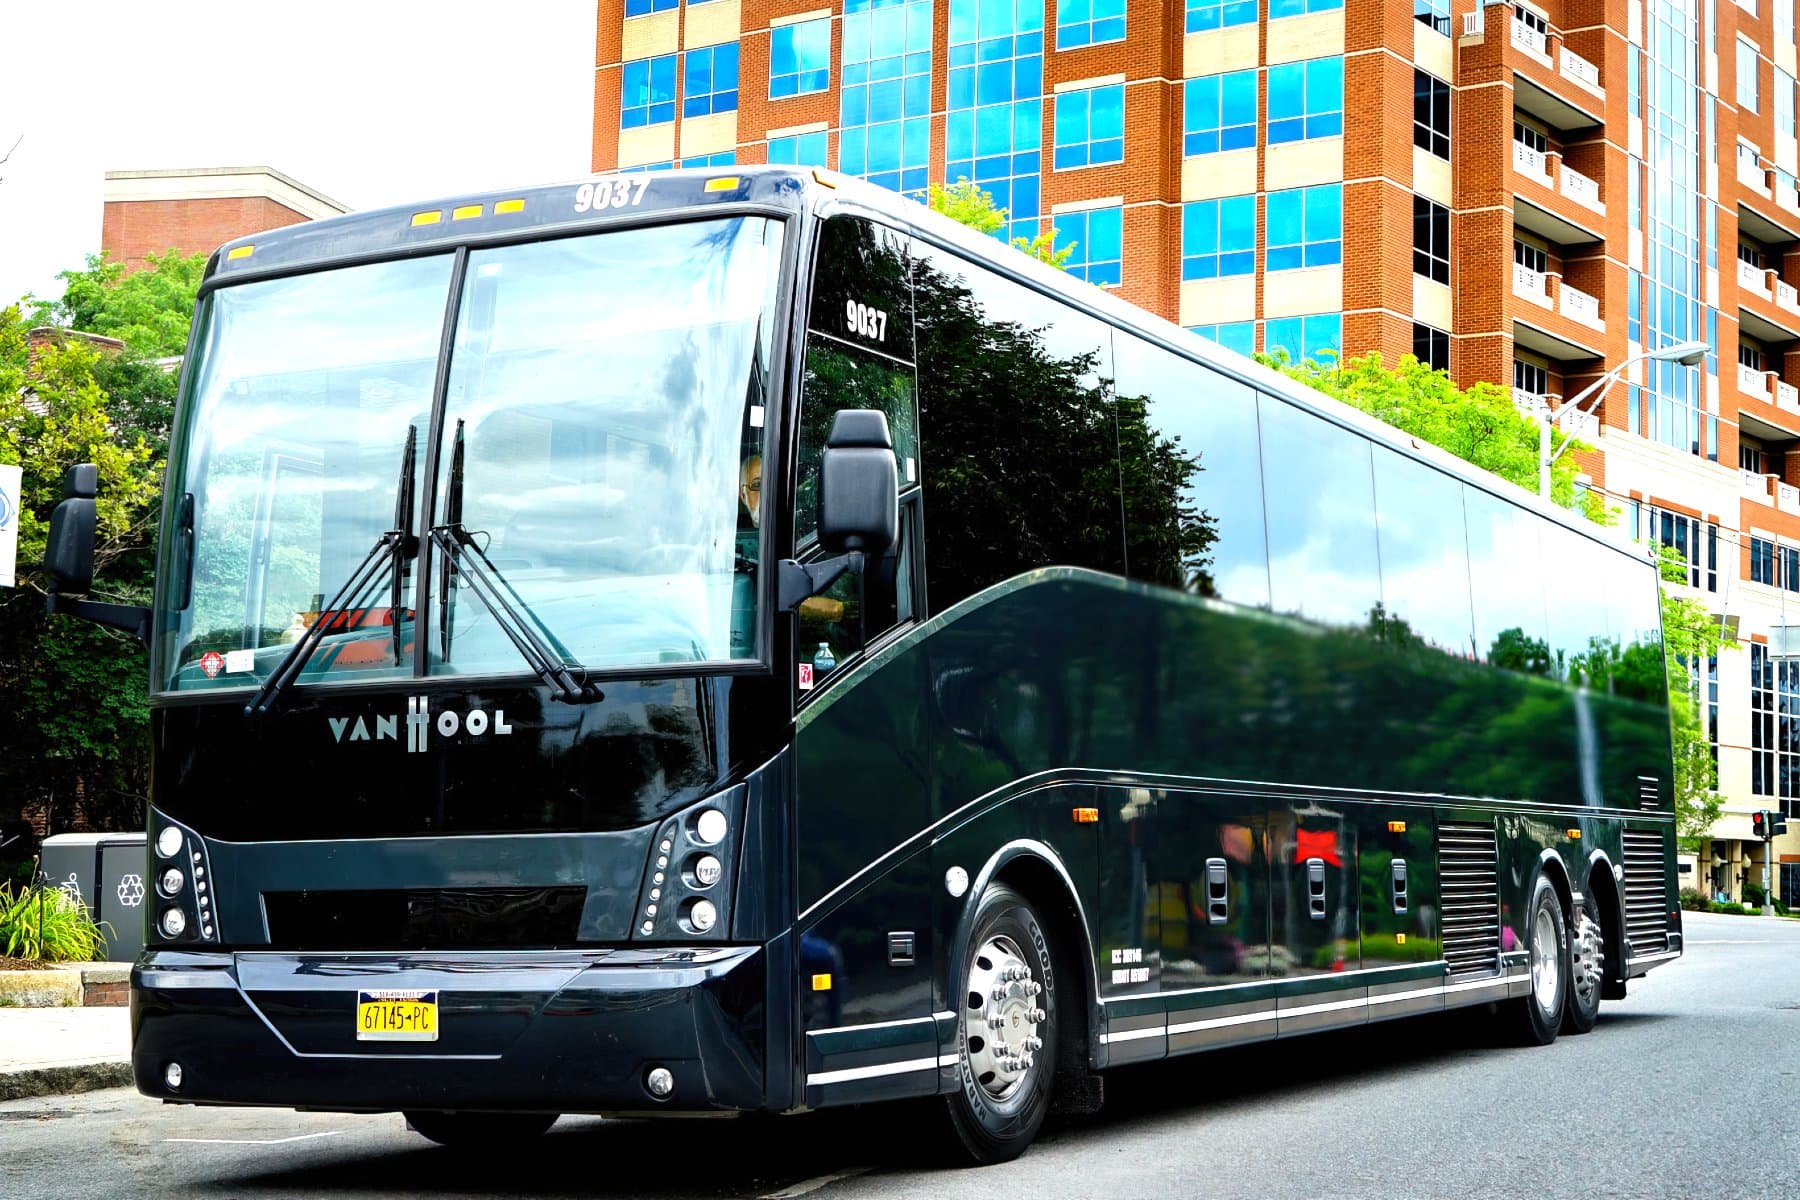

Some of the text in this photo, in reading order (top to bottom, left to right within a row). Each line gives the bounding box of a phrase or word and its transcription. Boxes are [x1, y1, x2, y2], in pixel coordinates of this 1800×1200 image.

[574, 176, 652, 213] 9037
[846, 299, 887, 342] 9037
[328, 695, 513, 753] VAN HOOL
